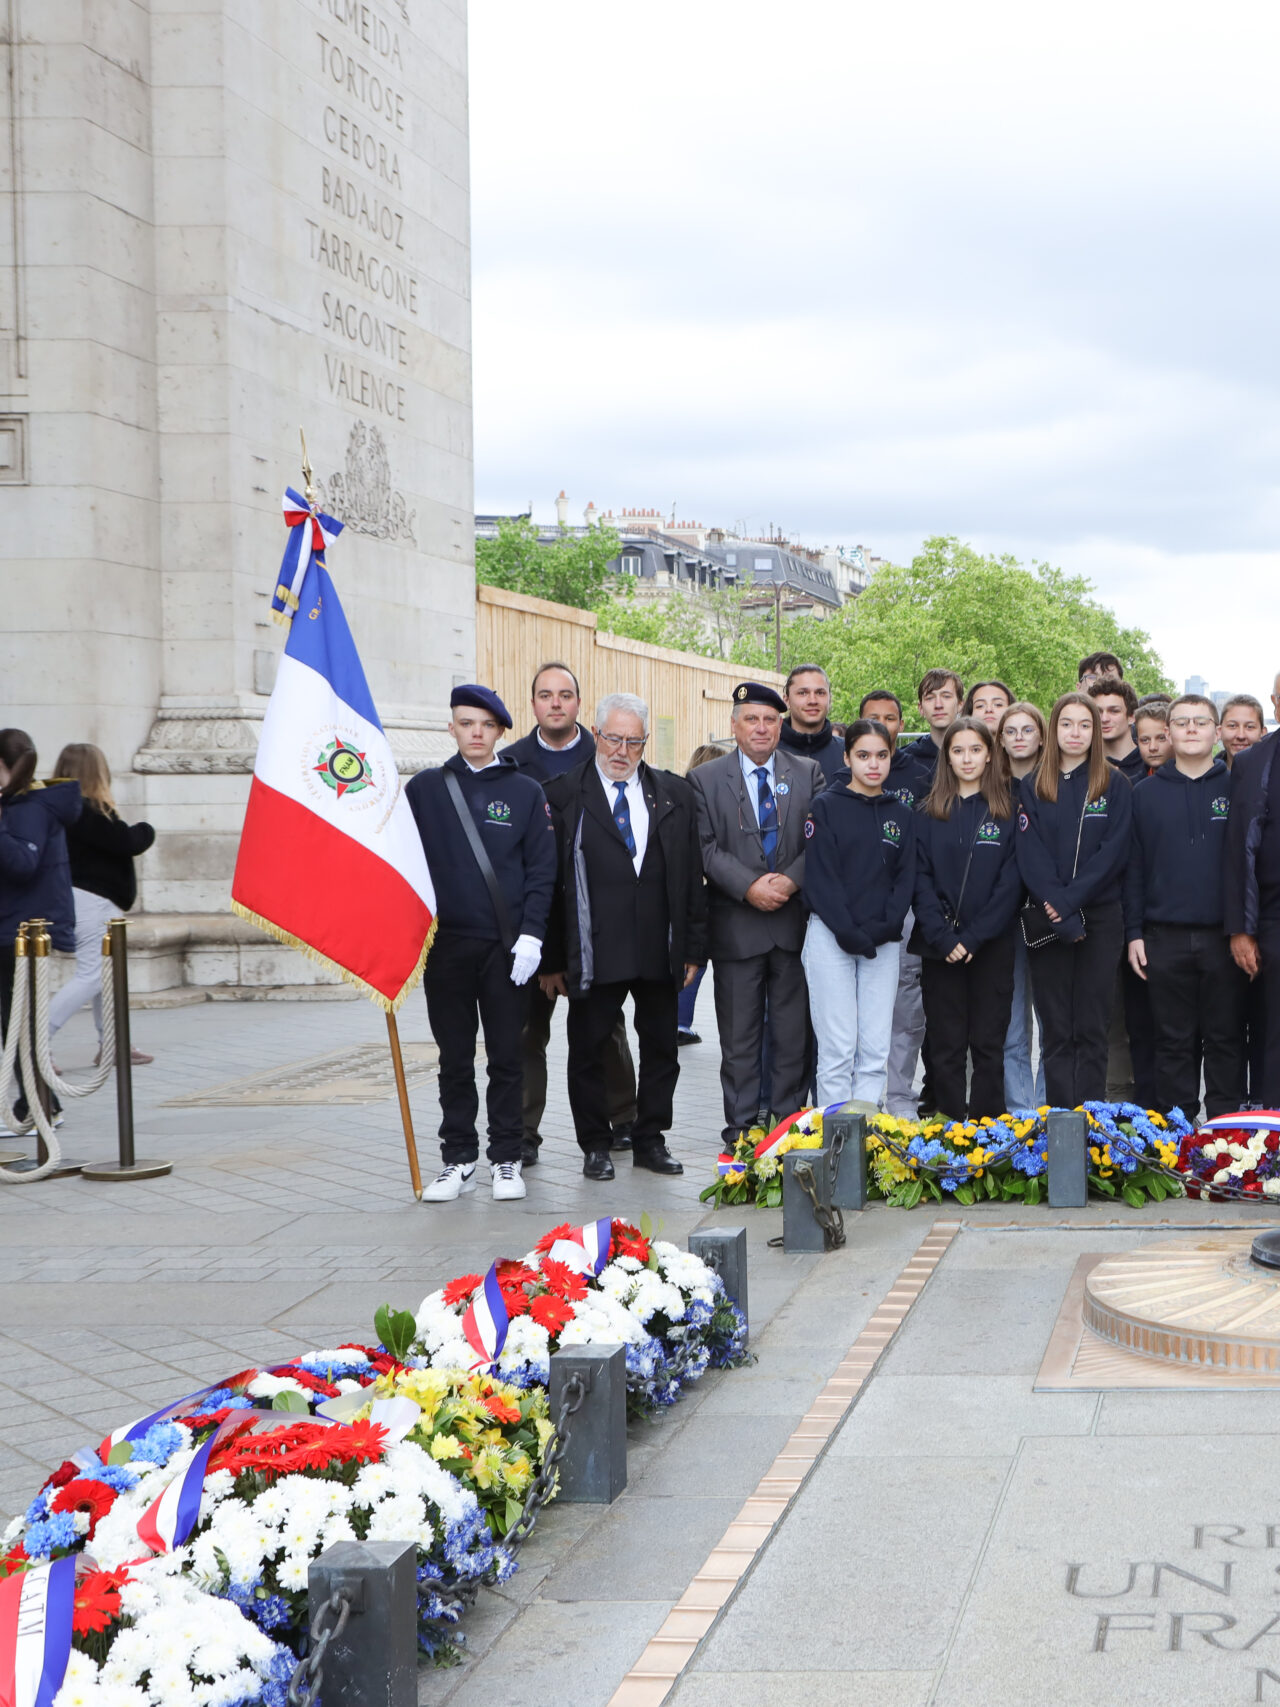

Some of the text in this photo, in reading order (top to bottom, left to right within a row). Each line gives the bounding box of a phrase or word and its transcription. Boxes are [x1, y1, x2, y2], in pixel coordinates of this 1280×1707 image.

[316, 31, 404, 131] TORTOSE
[322, 166, 404, 250] BADAJOZ
[324, 353, 405, 421] VALENCE
[1062, 1560, 1235, 1599] UN
